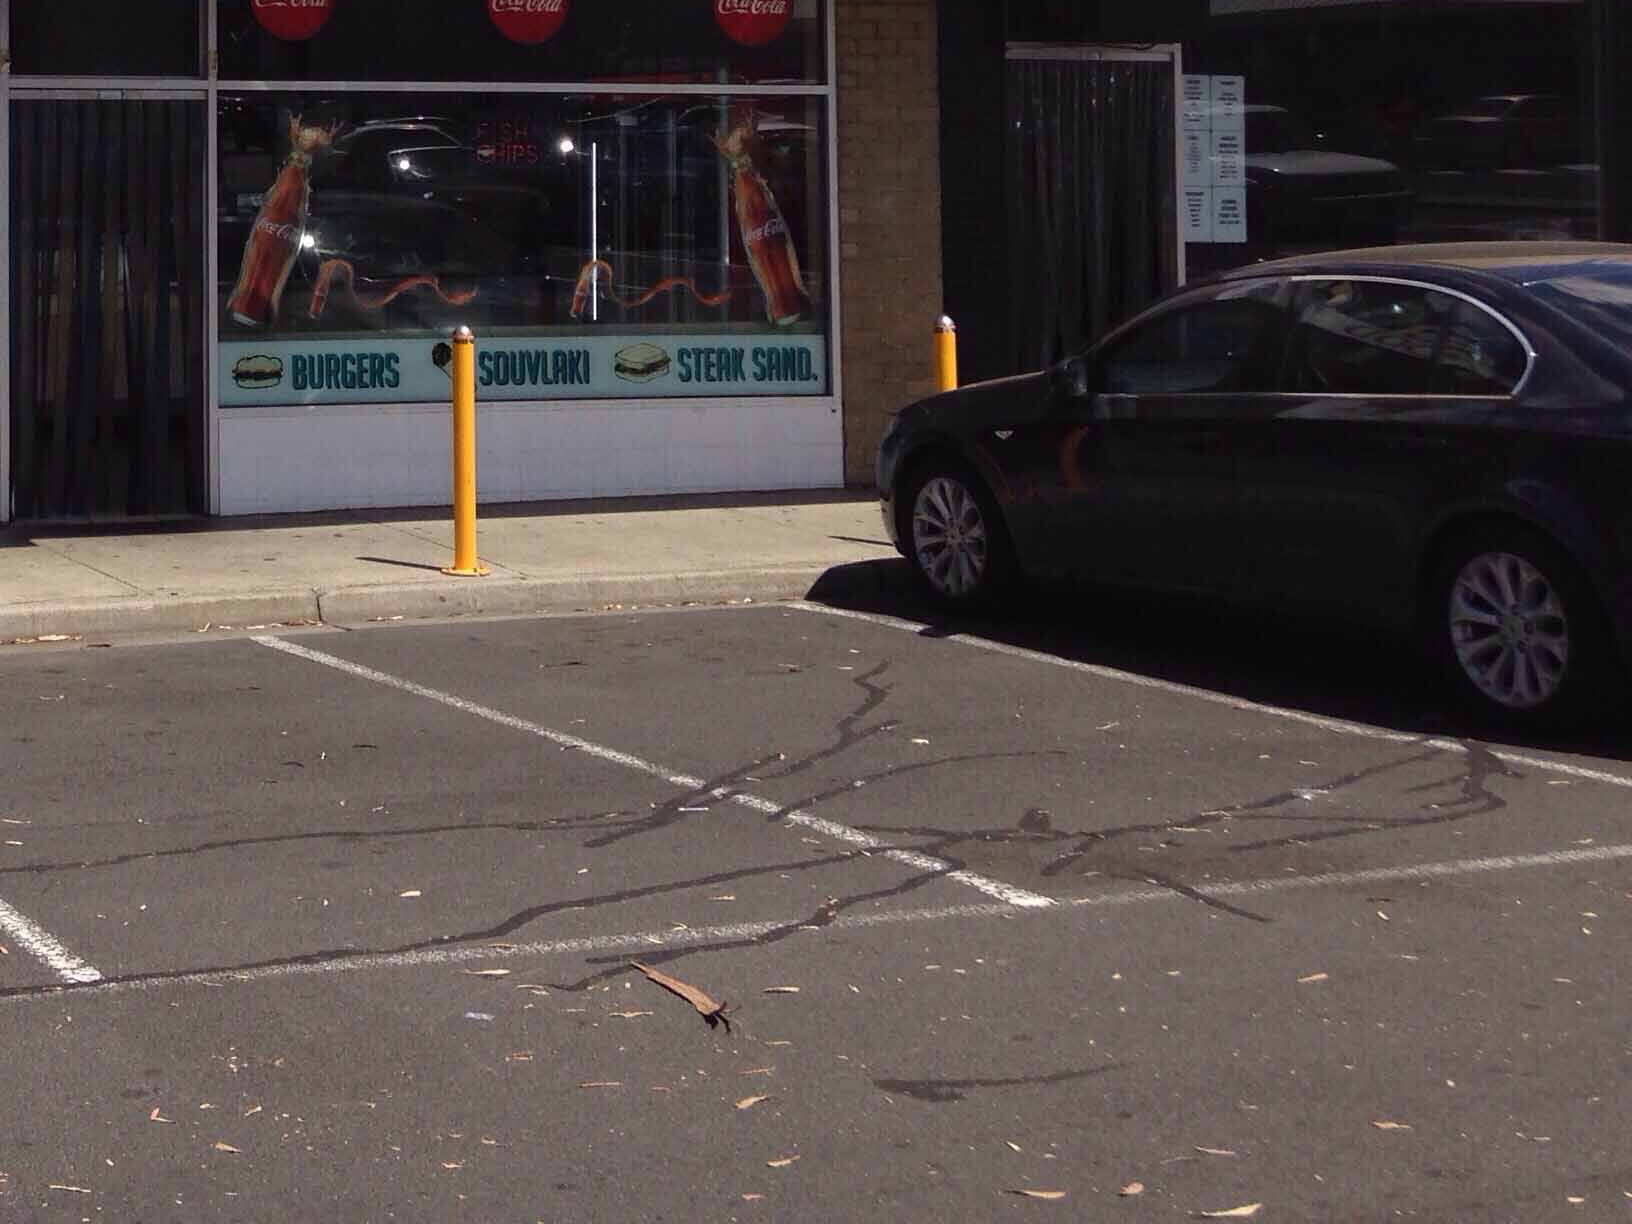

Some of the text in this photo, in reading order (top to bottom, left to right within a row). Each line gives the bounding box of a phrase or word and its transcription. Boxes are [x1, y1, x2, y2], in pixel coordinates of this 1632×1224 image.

[291, 345, 819, 391] BURGERS SOUVLAKI STEAK SAND.
